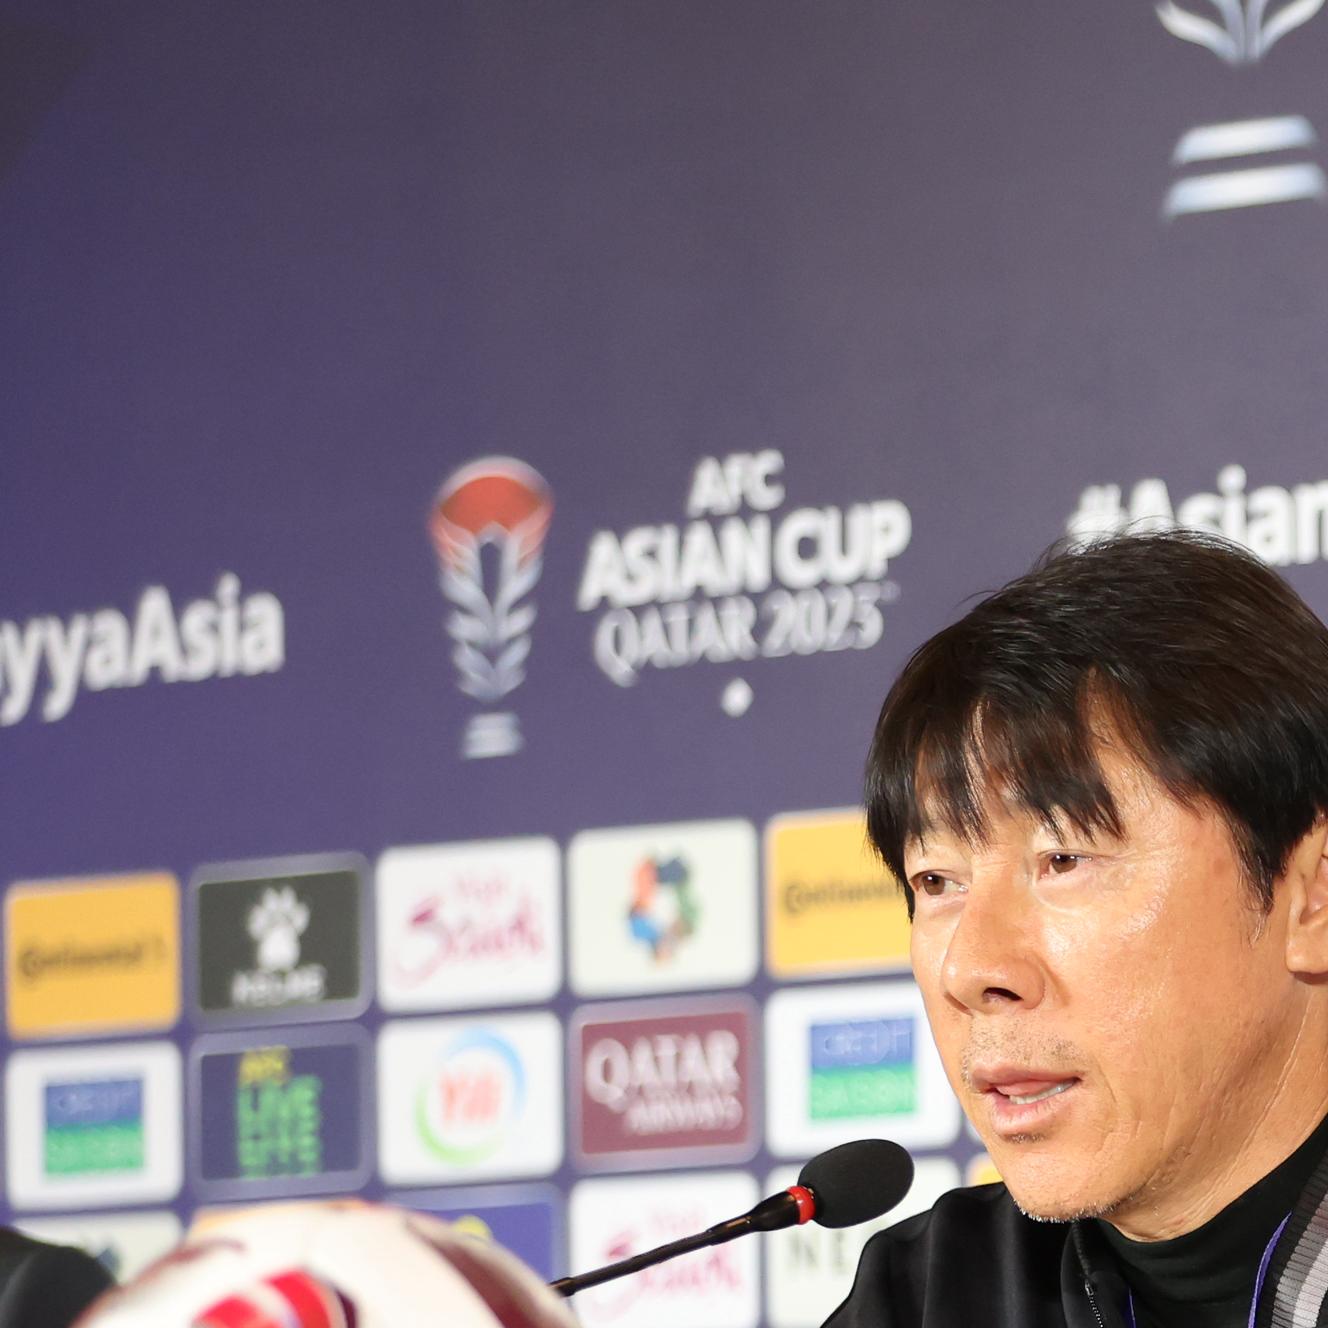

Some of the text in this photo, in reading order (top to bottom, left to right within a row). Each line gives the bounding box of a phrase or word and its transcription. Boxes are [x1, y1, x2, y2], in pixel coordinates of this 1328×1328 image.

[687, 449, 785, 517] AFC
[578, 498, 912, 611] ASIAN CUP
[594, 594, 762, 686] QATAR
[585, 1030, 740, 1112] QATAR
